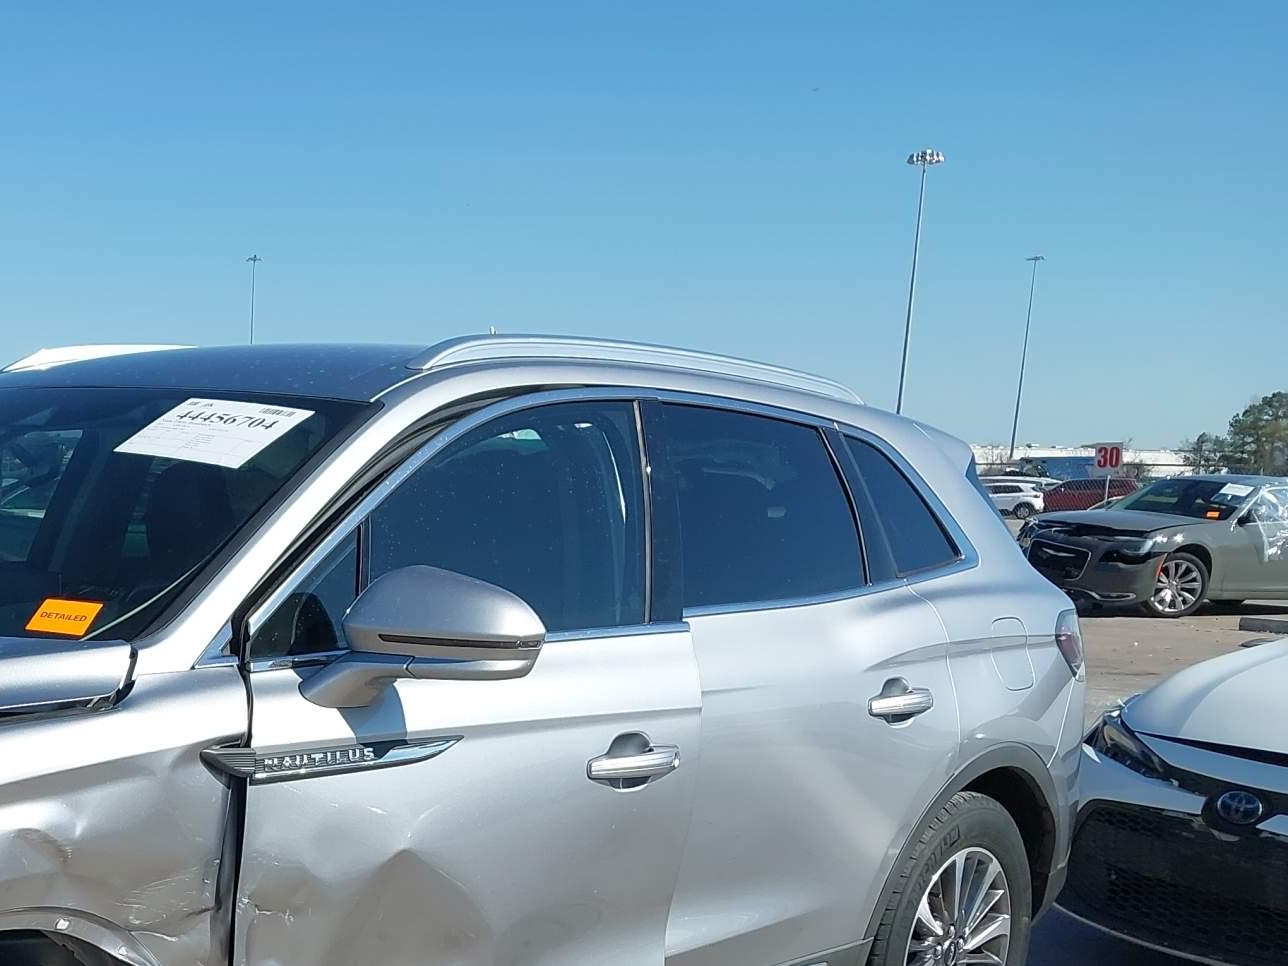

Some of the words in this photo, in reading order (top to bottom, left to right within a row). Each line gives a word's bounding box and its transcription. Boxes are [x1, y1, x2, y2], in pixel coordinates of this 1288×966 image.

[176, 410, 279, 430] 44456704
[1097, 446, 1120, 468] 30
[40, 611, 88, 622] DETAILED
[263, 747, 375, 771] NAUTILUS
